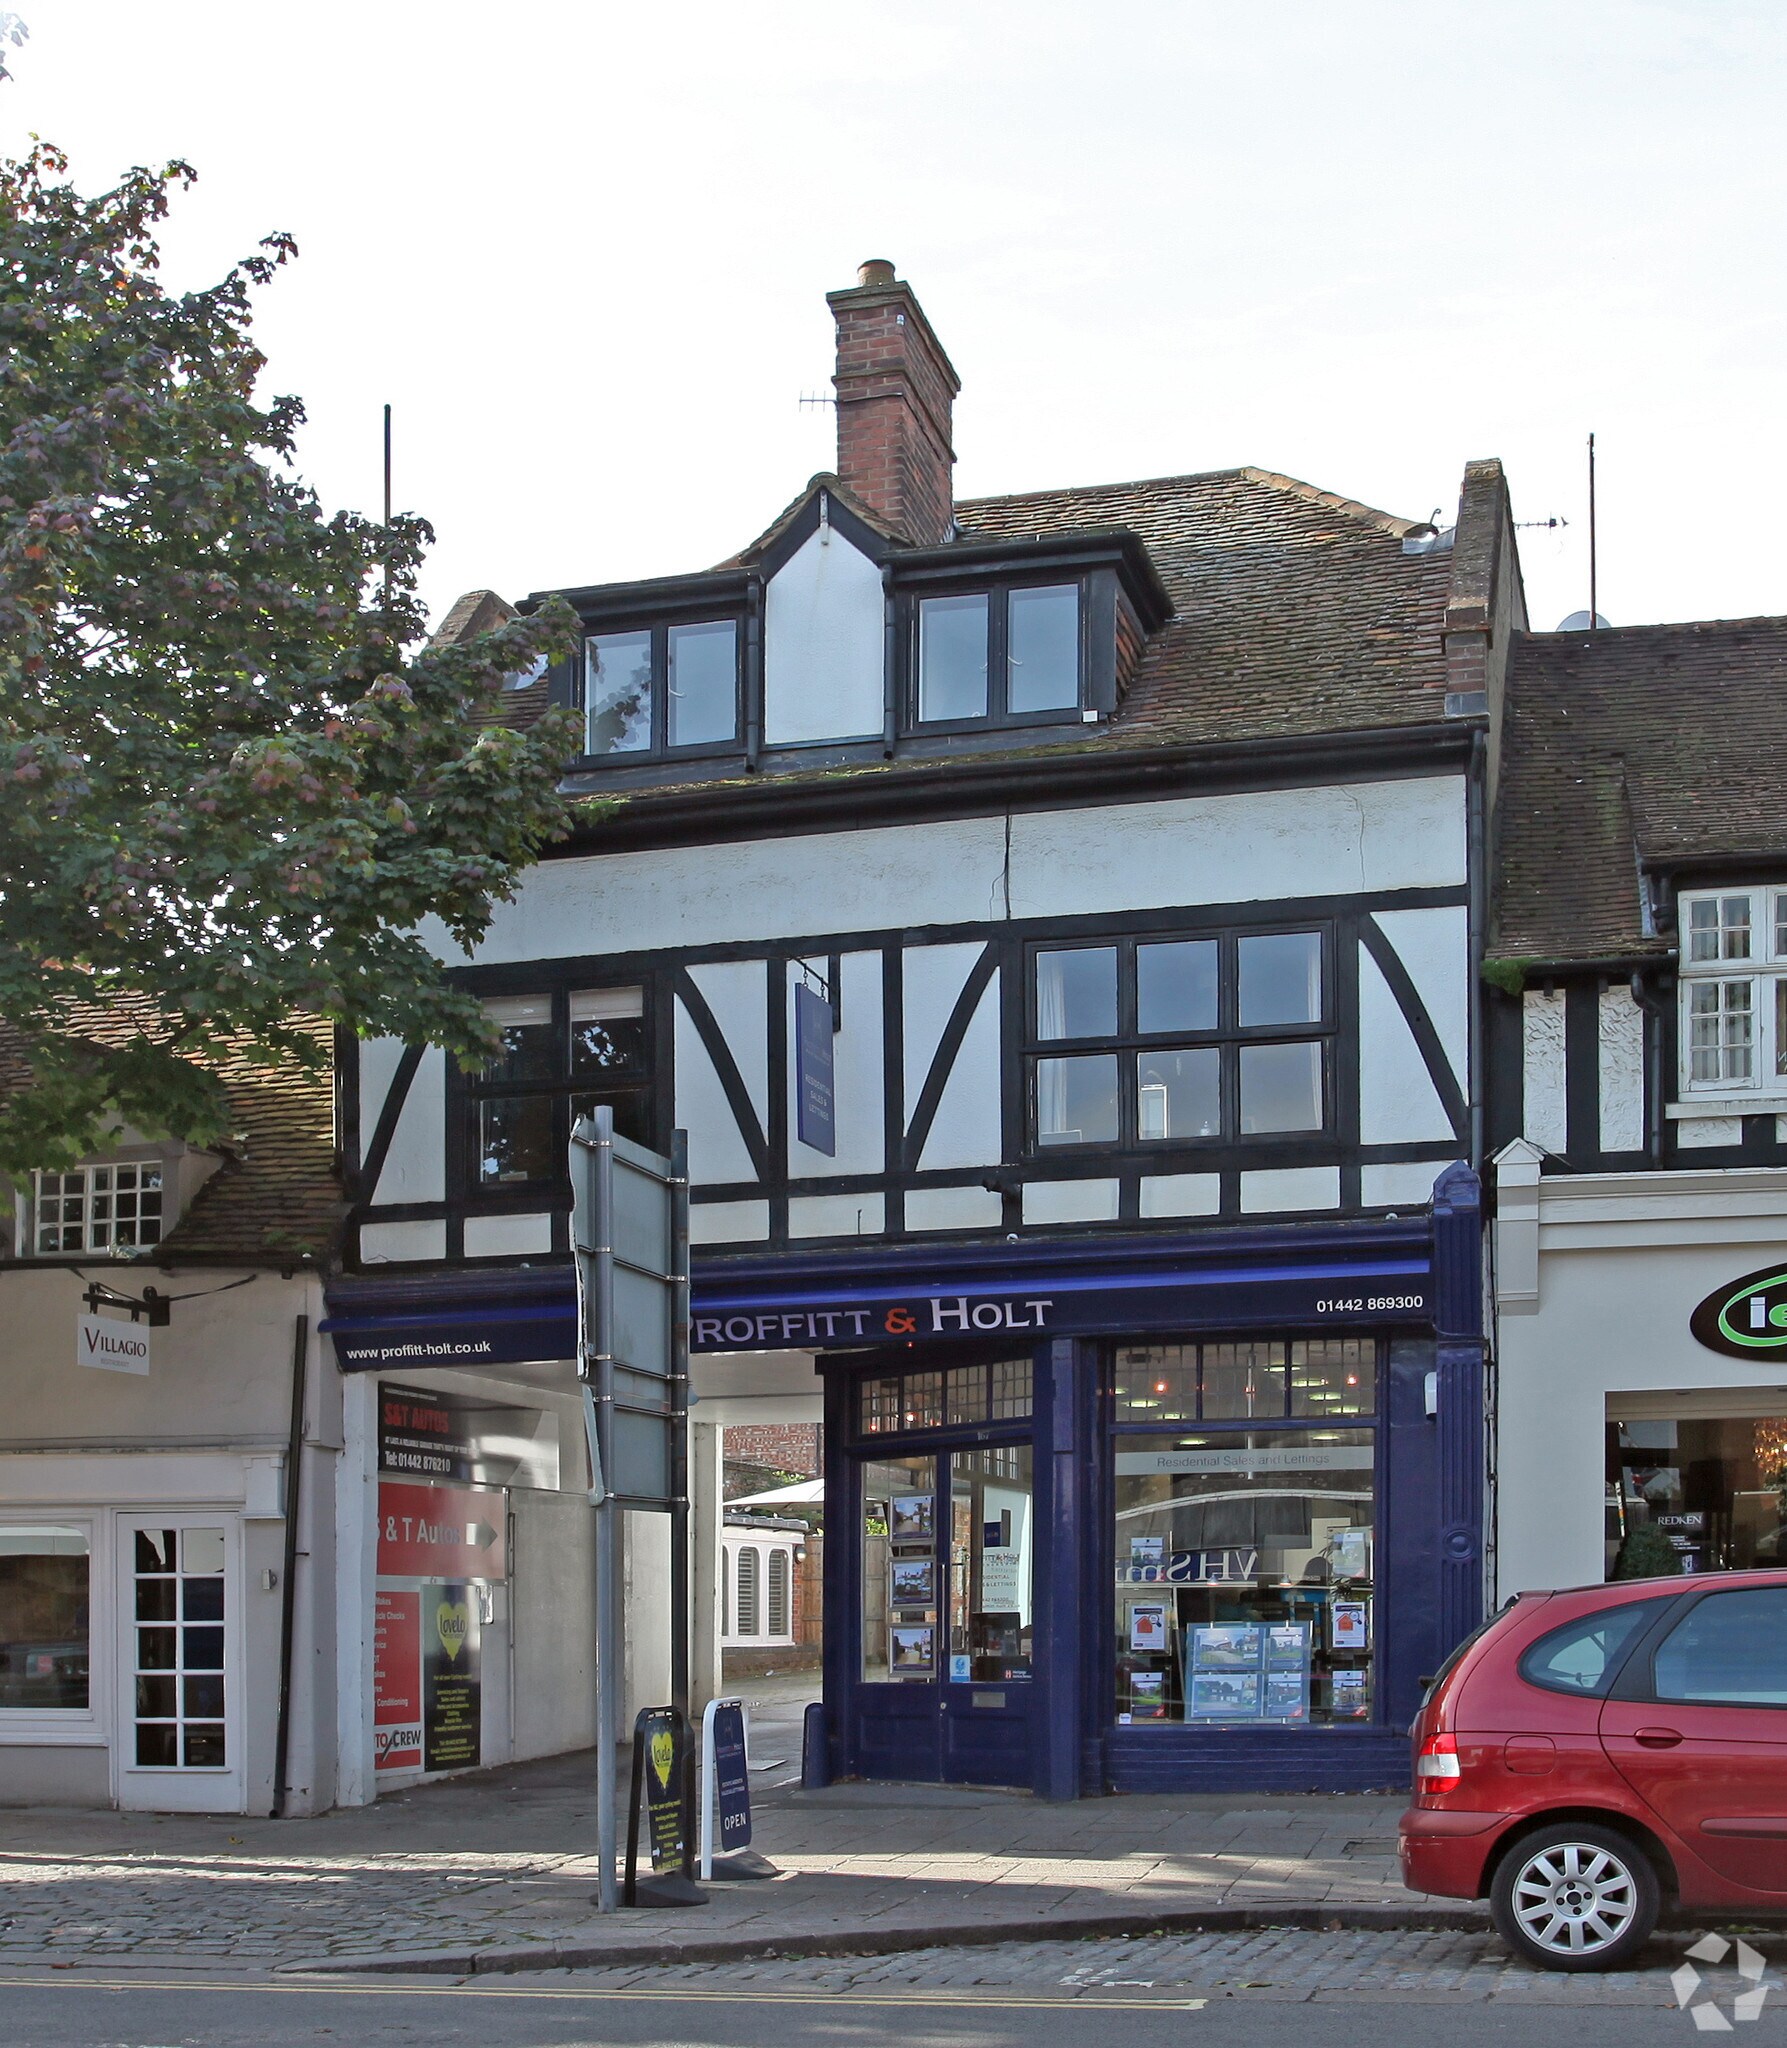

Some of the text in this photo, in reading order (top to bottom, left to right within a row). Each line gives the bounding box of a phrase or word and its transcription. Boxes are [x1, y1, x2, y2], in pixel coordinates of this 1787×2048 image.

[1316, 1295, 1423, 1313] 01442 869300
[689, 1297, 1054, 1344] ROFFITT & HOLT
[84, 1326, 147, 1358] VILLAGIO
[411, 1407, 449, 1434] AUTOS
[385, 1450, 451, 1473] Tel: 01442 876210
[1157, 1453, 1330, 1468] Residential Sales and Lettings
[386, 1516, 460, 1544] & T Autos
[1657, 1515, 1702, 1526] REDKEN
[724, 1812, 747, 1831] OPEN
